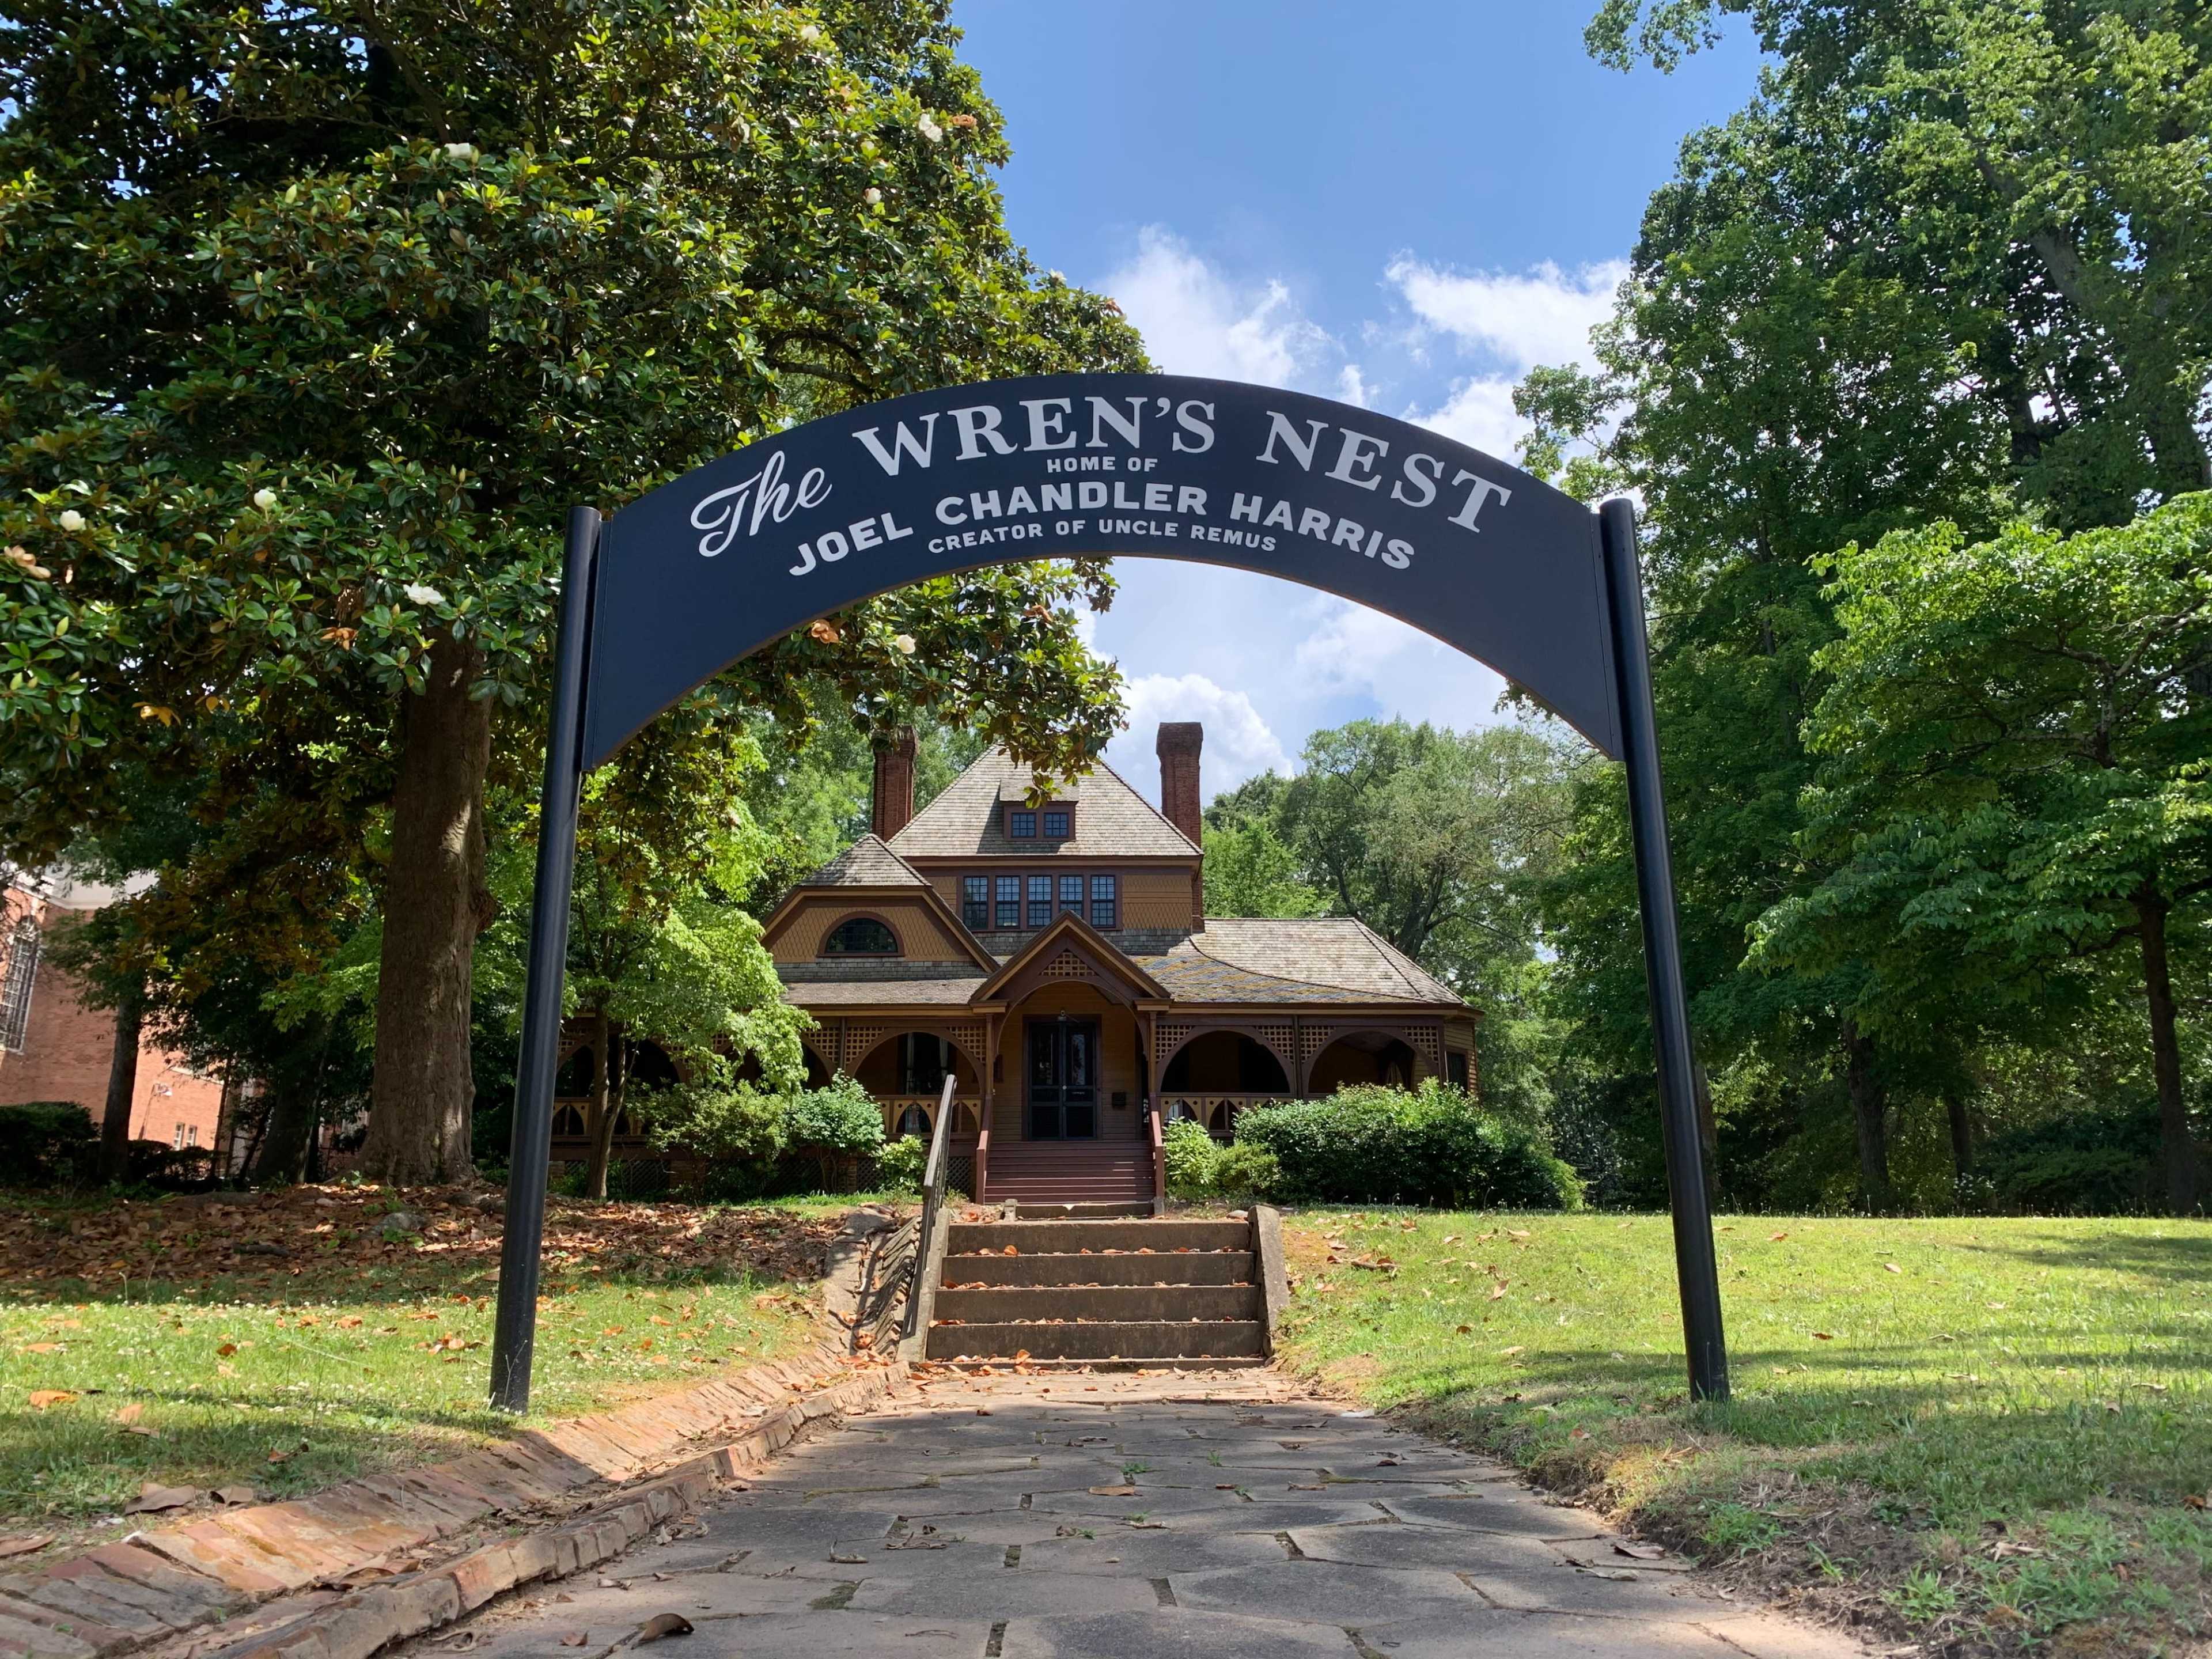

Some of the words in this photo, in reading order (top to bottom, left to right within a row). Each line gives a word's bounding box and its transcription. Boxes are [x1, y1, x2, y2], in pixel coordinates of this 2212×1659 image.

[690, 450, 832, 557] The
[1256, 411, 1512, 533] NEST
[1047, 456, 1116, 473] HOME
[1127, 457, 1158, 472] OF
[789, 512, 914, 576] JOEL
[935, 481, 1207, 525] CHANDLER
[1230, 493, 1414, 569] HARRIS
[928, 523, 1043, 554] CREATOR
[1055, 520, 1085, 535] OF
[1099, 519, 1179, 537] UNCLE
[1191, 525, 1276, 551] REMUS
